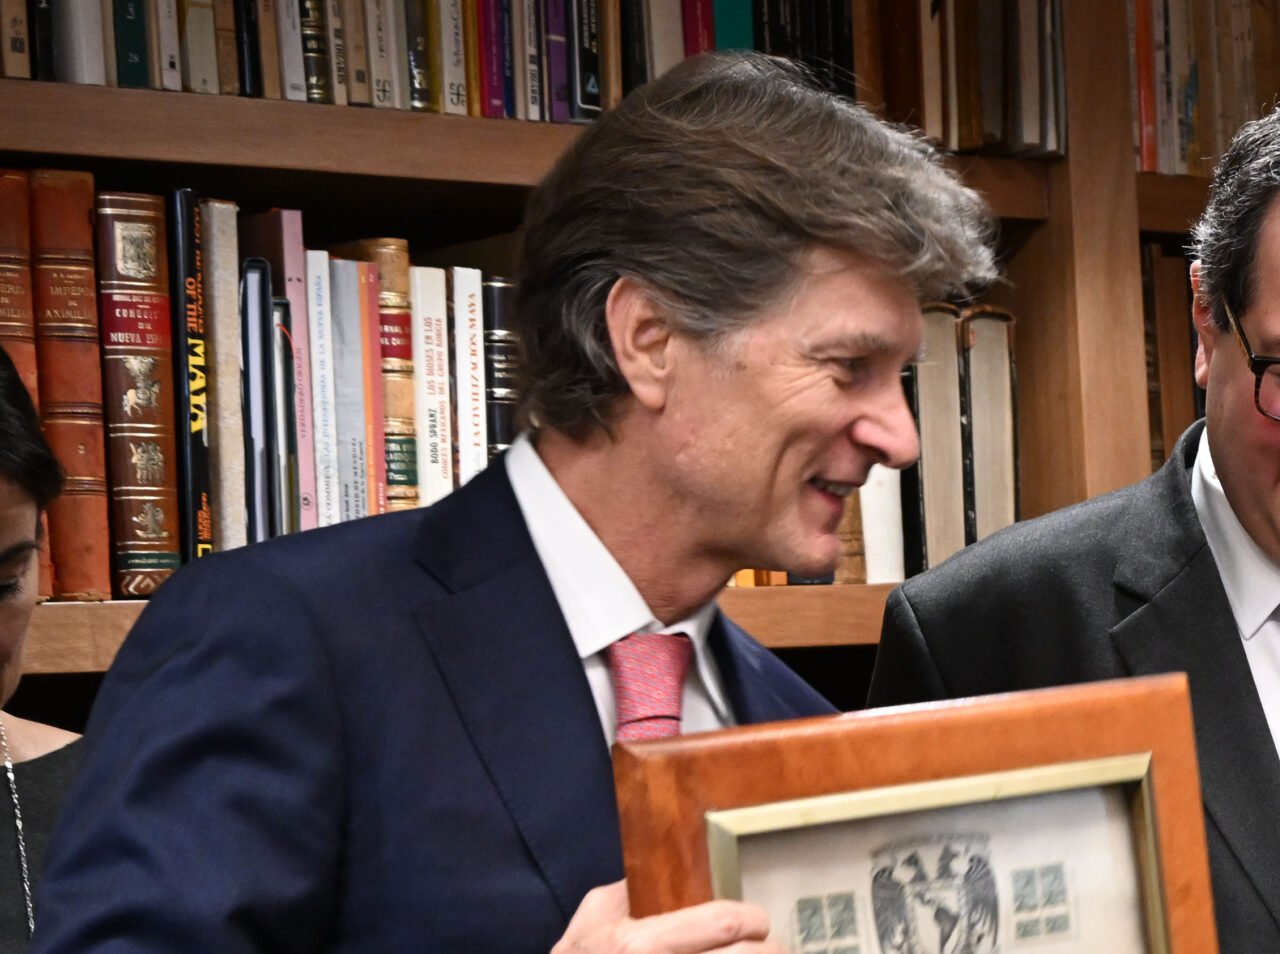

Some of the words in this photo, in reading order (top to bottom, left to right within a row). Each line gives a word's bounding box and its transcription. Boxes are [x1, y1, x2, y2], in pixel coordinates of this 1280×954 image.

[185, 277, 197, 299] OF
[186, 303, 198, 333] THE
[466, 293, 477, 330] MAYA
[423, 317, 433, 332] LOS
[110, 332, 142, 344] NUEVA
[424, 335, 433, 346] EN
[187, 337, 207, 434] MAYA
[426, 380, 436, 396] LOS
[436, 382, 446, 396] DEL
[471, 430, 482, 448] LA
